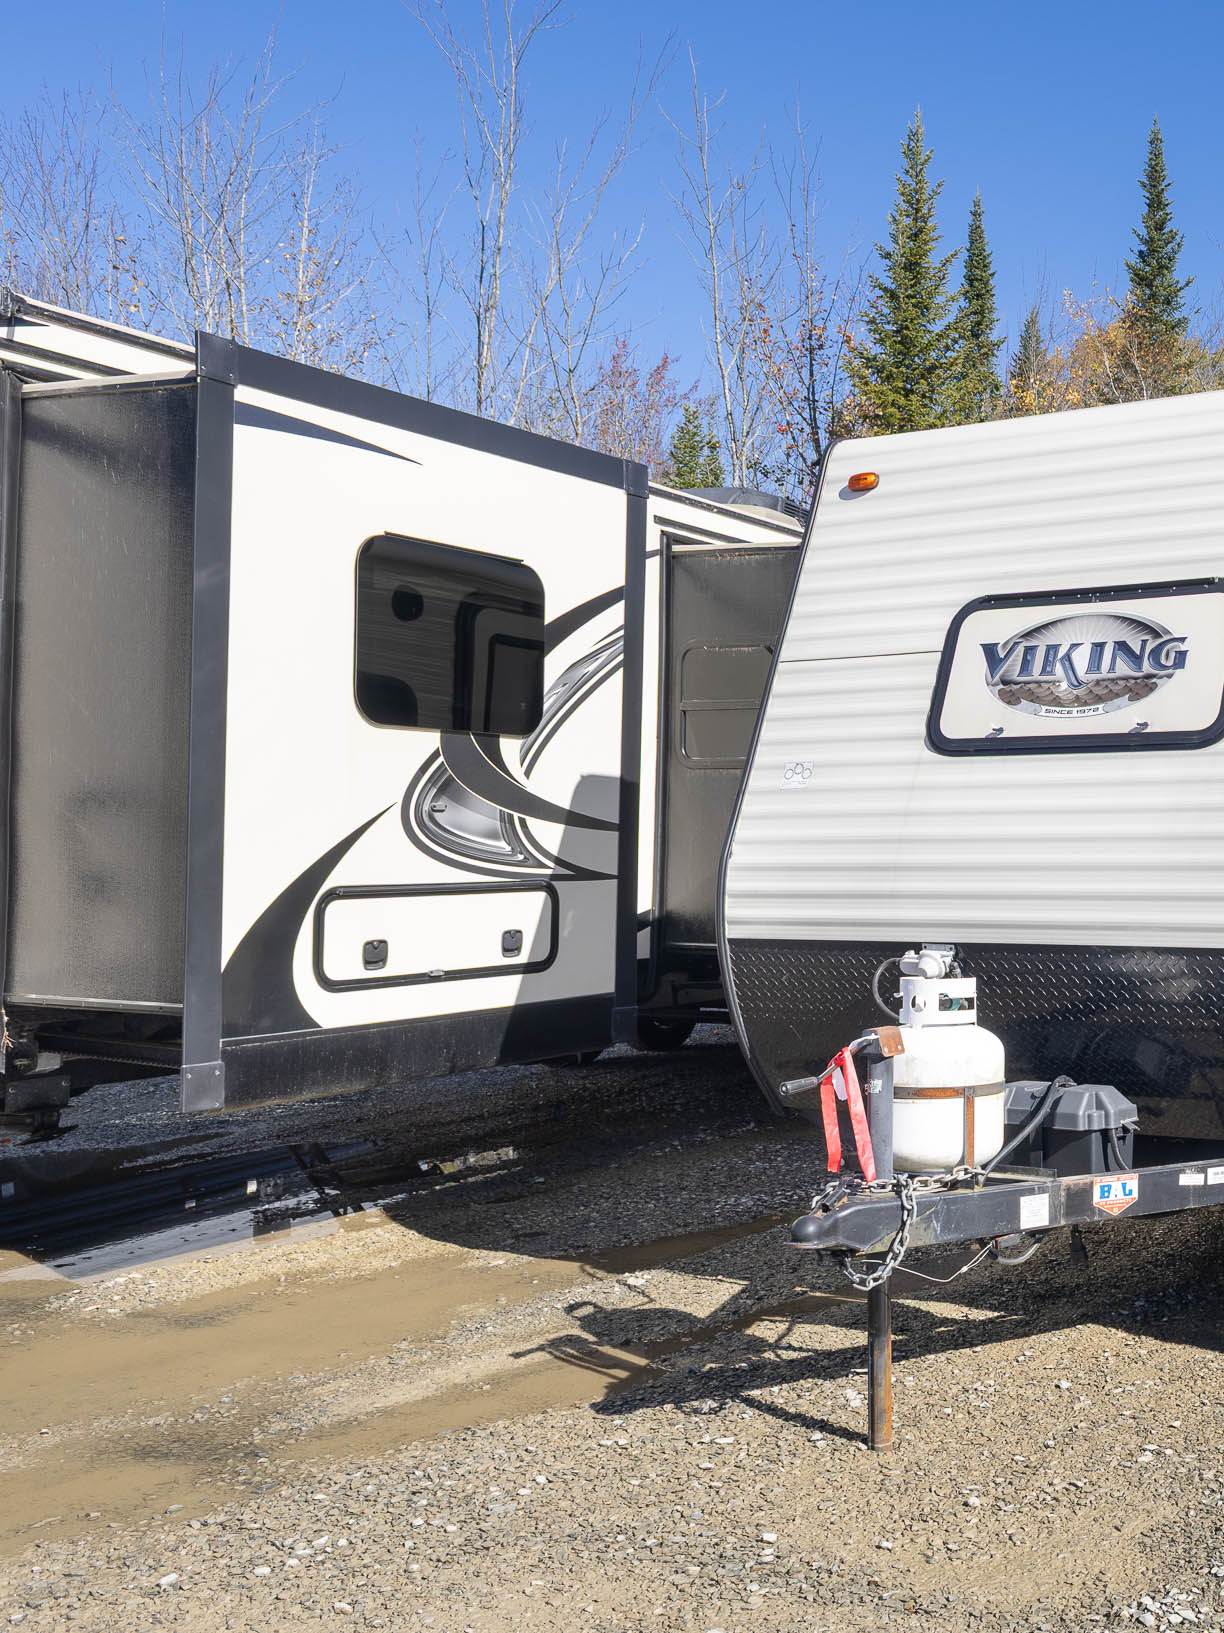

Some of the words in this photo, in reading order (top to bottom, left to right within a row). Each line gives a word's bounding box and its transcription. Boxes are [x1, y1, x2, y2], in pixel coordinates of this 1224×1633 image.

[979, 636, 1189, 690] VIKING
[1076, 706, 1099, 714] 1972
[1099, 1182, 1133, 1200] BL
